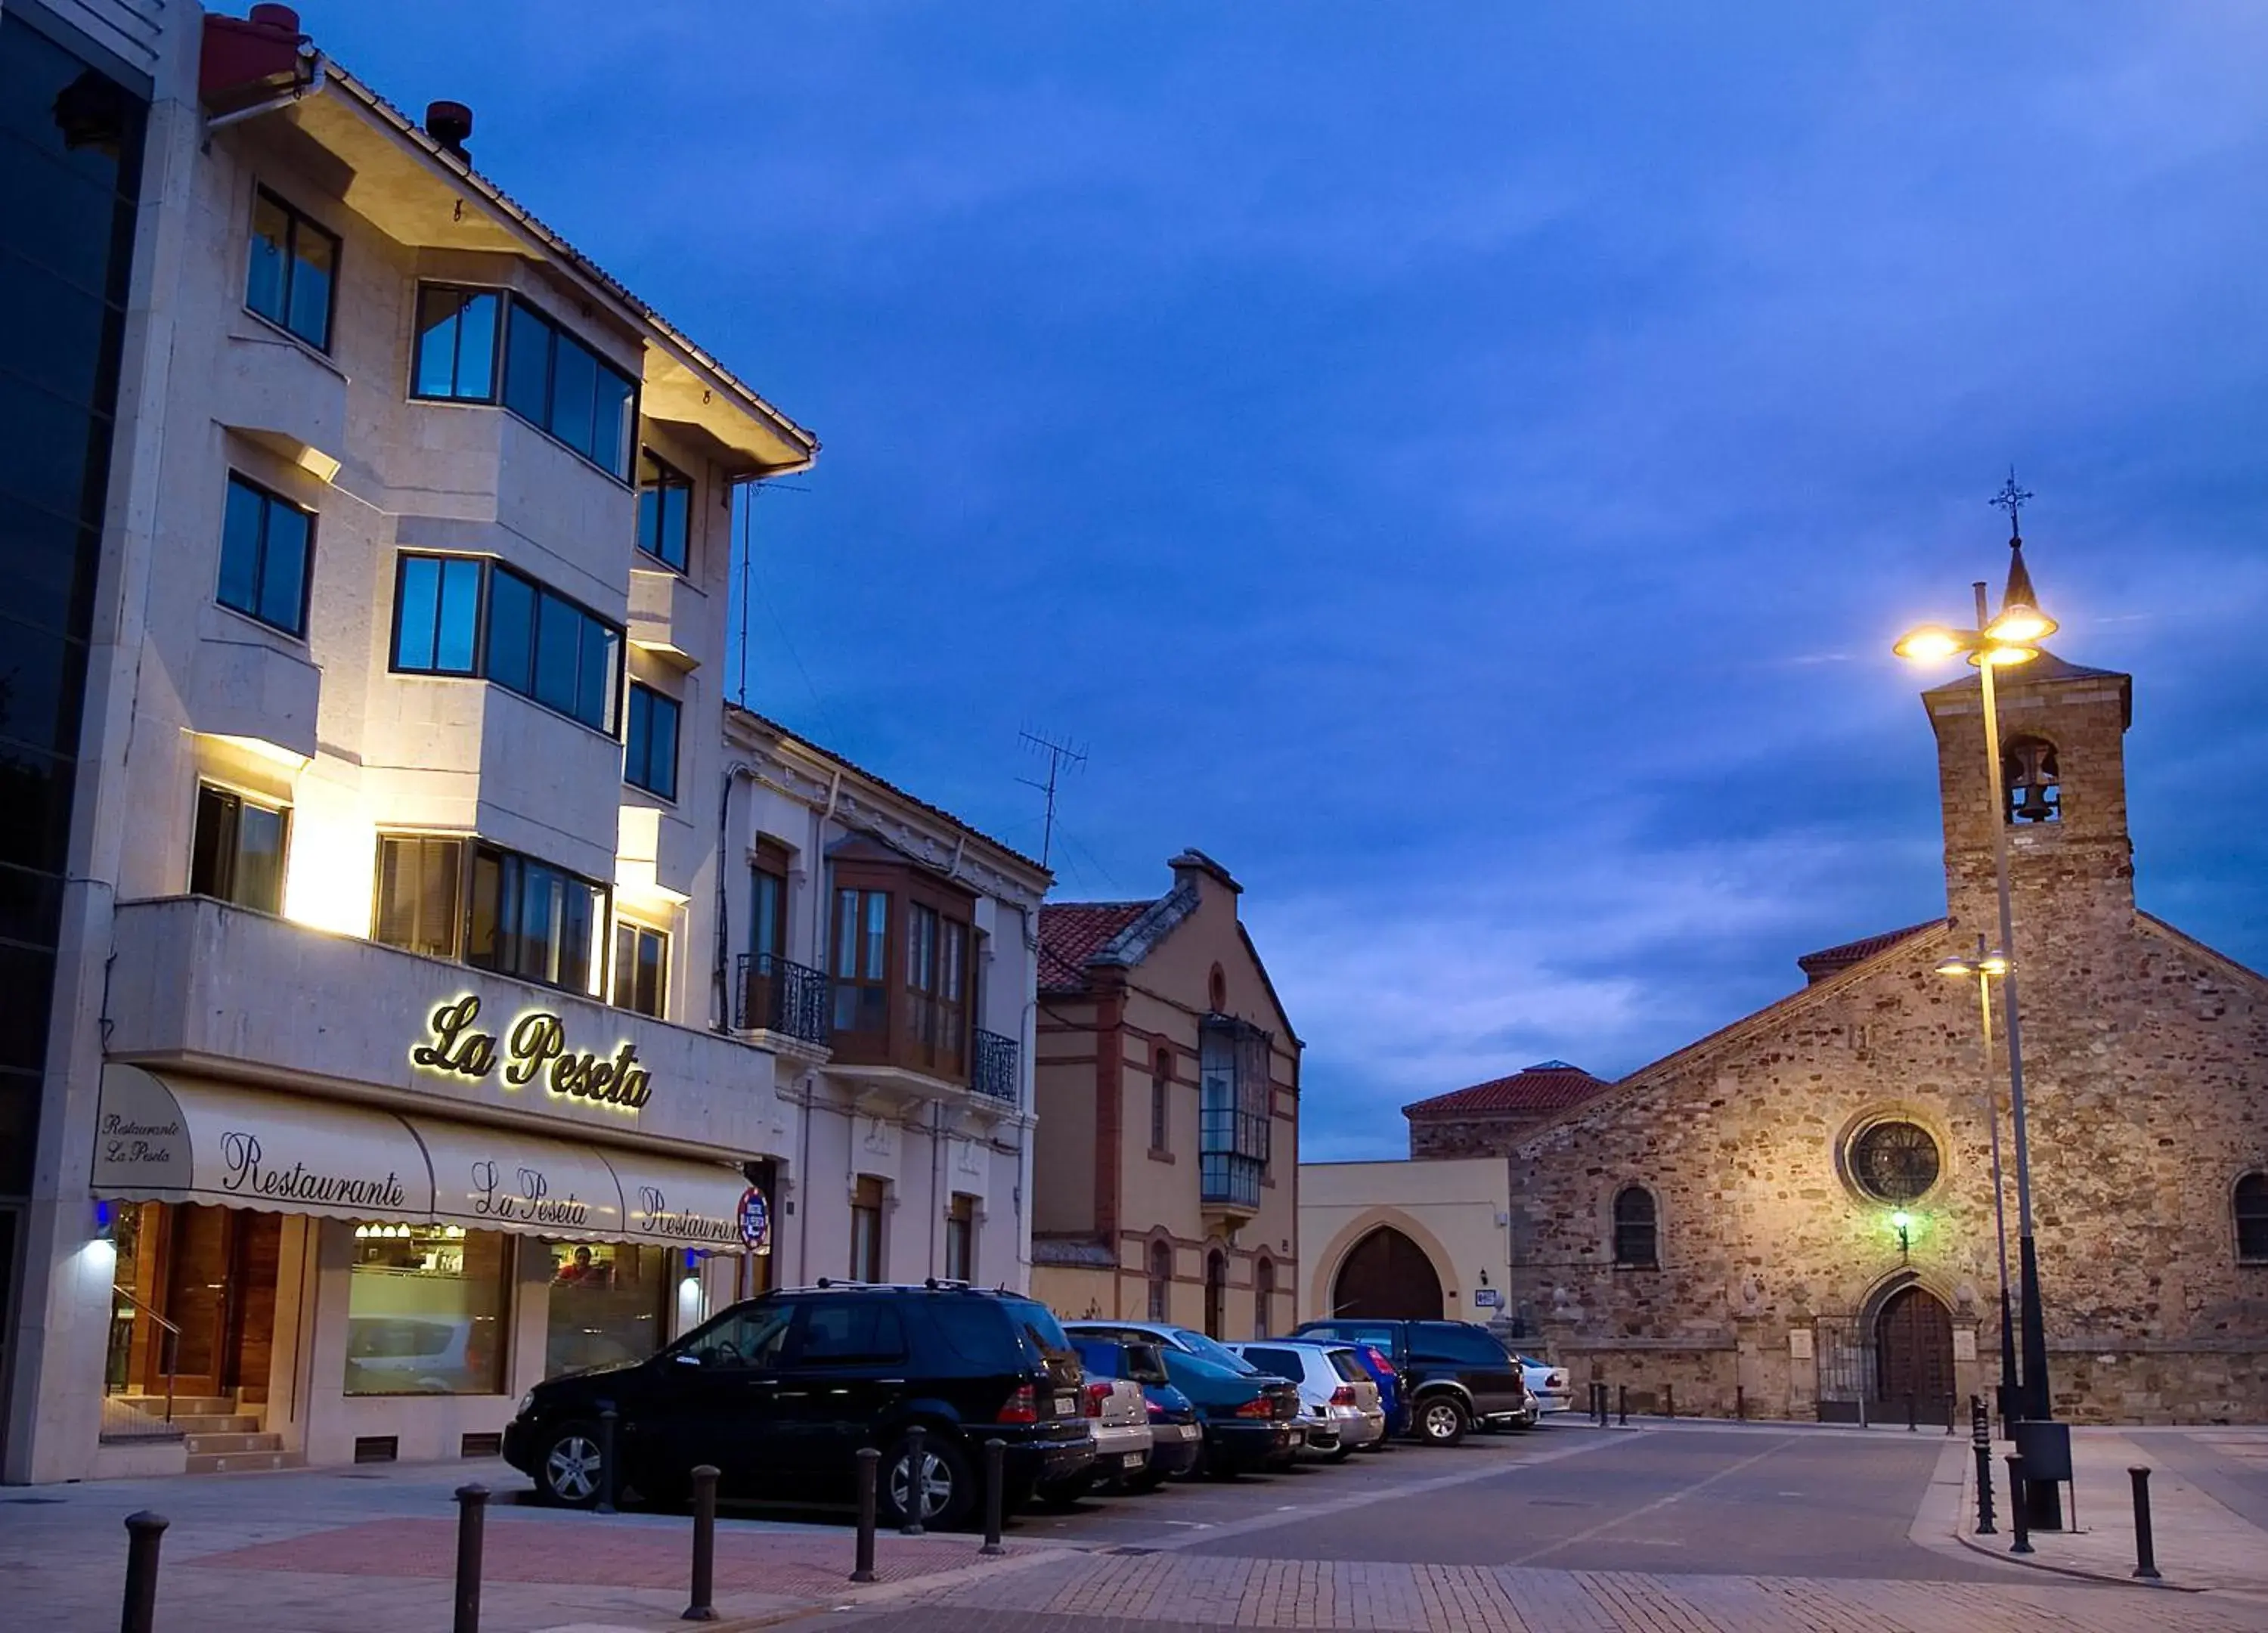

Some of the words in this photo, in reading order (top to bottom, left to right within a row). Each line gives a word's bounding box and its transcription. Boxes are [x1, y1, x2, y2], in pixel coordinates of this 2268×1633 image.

[414, 995, 497, 1077] La
[506, 1013, 652, 1108] Peseta
[102, 1114, 179, 1136] Restaurante
[105, 1139, 125, 1163] La
[129, 1140, 170, 1163] Peseta
[220, 1132, 404, 1207] Restaurante
[471, 1160, 515, 1218] La
[516, 1167, 587, 1225] Peseta
[638, 1185, 742, 1241] Restauran
